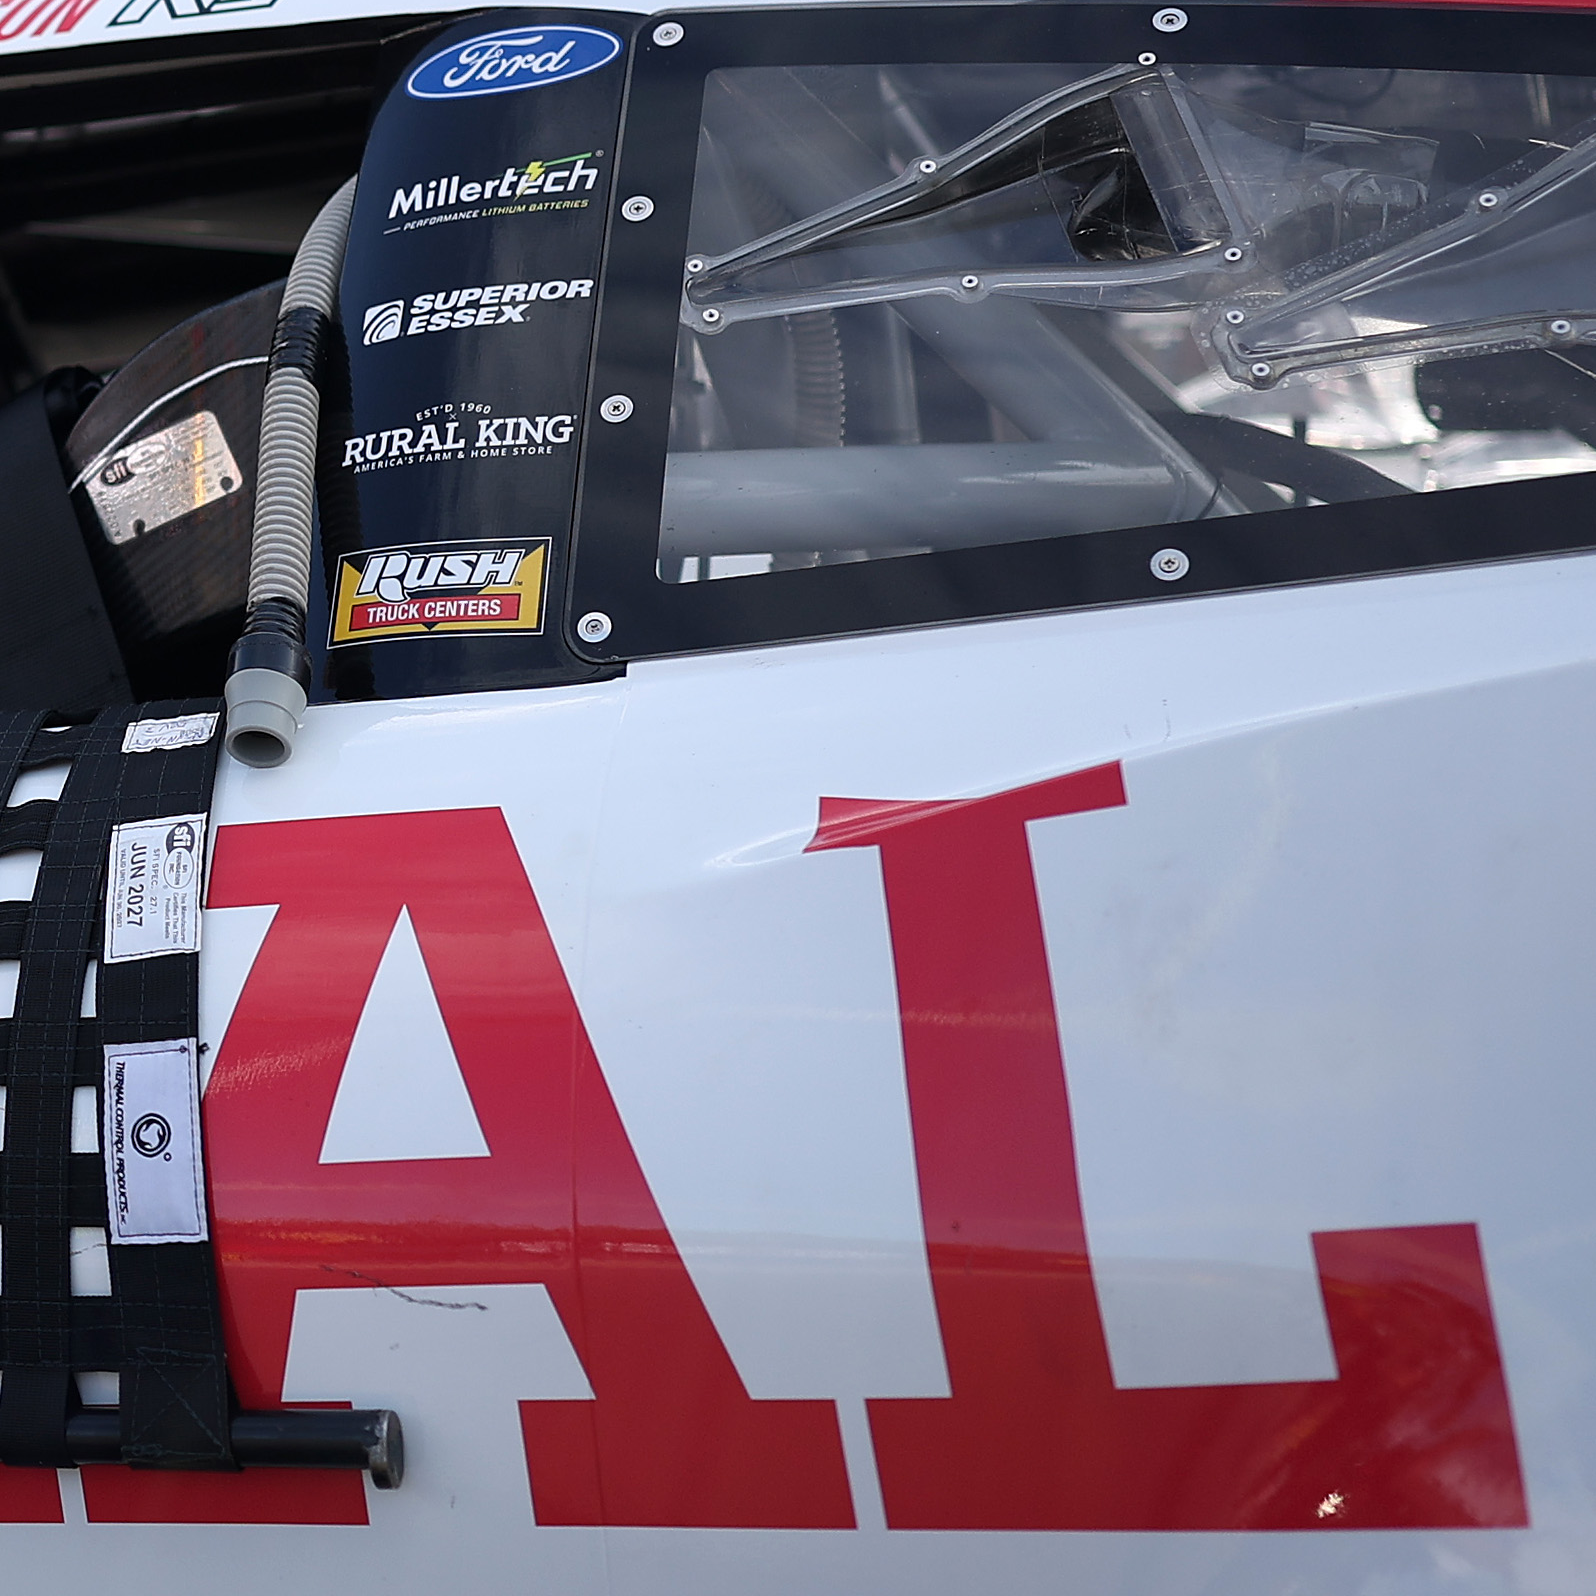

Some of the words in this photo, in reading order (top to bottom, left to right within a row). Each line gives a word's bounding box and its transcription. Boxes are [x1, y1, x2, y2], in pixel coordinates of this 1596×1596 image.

[442, 35, 578, 89] Ford
[387, 158, 599, 220] Millertech
[403, 208, 481, 231] PERFORMANCE
[481, 204, 527, 217] LITHIUM
[527, 198, 590, 212] BATTERIES
[409, 278, 595, 315] SUPERIOR
[406, 303, 531, 336] ESSEX
[415, 403, 454, 422] EST'D
[459, 402, 492, 415] 1960
[341, 421, 467, 468] RURAL
[475, 415, 575, 448] KING
[353, 456, 415, 474] AMERICA'S
[419, 452, 453, 464] FARM
[457, 450, 466, 459] &
[470, 448, 508, 459] HOME
[512, 445, 554, 456] STORE
[356, 550, 526, 603] RUSH
[366, 602, 420, 624] TRUCK
[424, 598, 502, 617] CENTERS
[119, 848, 127, 868] VALID
[129, 842, 147, 879] JUN
[118, 869, 126, 888] UNTIL
[126, 883, 144, 927] 2027
[149, 896, 158, 915] 27.1
[113, 1061, 126, 1107] THERMAL
[112, 1107, 125, 1155] CONTROL
[113, 1156, 129, 1214] PRODUCTS
